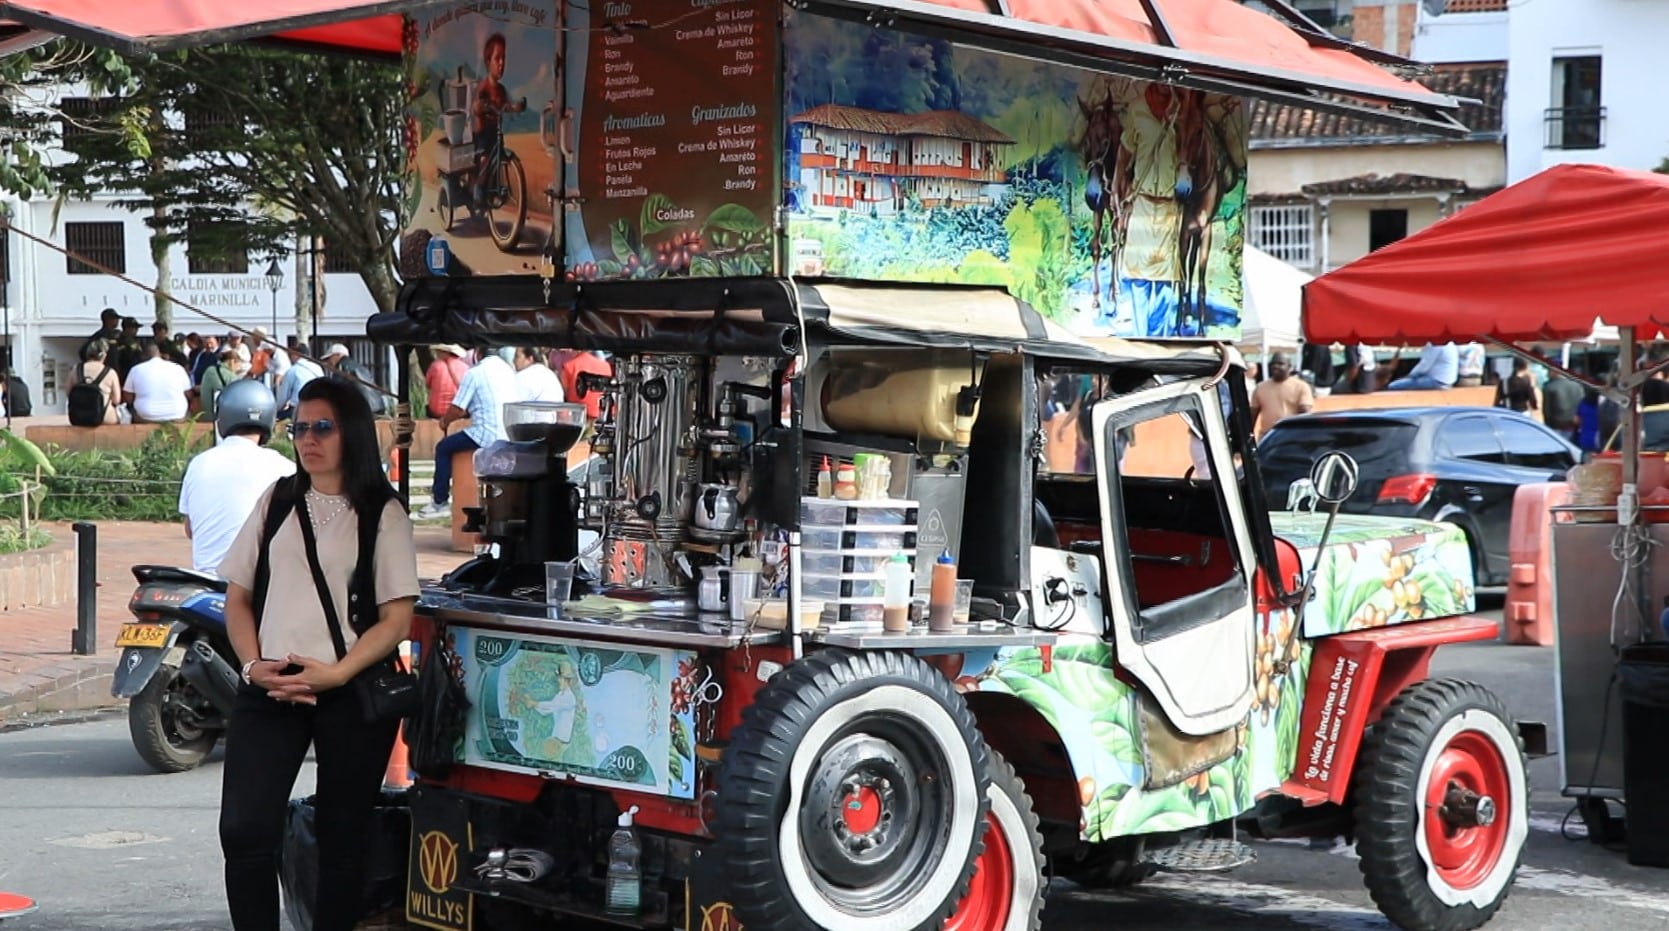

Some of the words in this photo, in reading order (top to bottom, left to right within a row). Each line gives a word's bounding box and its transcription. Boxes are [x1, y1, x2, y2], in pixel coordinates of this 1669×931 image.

[604, 2, 631, 17] Tinto
[715, 11, 730, 21] Sin
[731, 9, 754, 20] Licor
[675, 30, 703, 40] Crema
[704, 27, 715, 36] de
[716, 23, 754, 35] Whiskey
[717, 37, 754, 48] Amareto
[604, 49, 621, 59] Ron
[735, 50, 754, 61] Ron
[604, 61, 634, 73] Brandy
[722, 63, 754, 76] Brandy
[604, 87, 655, 102] Aguardiente
[692, 102, 757, 125] Granizados
[603, 111, 666, 133] Aromaticas
[717, 126, 731, 136] Sin
[733, 124, 756, 135] Licor
[605, 136, 631, 146] Limon
[678, 143, 705, 154] Crema
[707, 141, 717, 150] de
[719, 138, 756, 150] Whiskey
[605, 149, 631, 159] Frutos
[633, 147, 656, 159] Rojos
[719, 152, 756, 163] Amareto
[605, 162, 617, 172] En
[618, 161, 642, 171] Leche
[738, 164, 756, 175] Ron
[605, 174, 633, 185] Panela
[724, 178, 756, 190] Brandy
[606, 186, 648, 198] Manzanilla
[656, 208, 695, 221] Coladas
[171, 278, 216, 290] CALDIA
[189, 294, 259, 306] MARINILLA
[479, 640, 503, 655] 200
[1331, 656, 1345, 680] base
[1330, 682, 1339, 690] a
[1315, 691, 1336, 741] funciona
[1310, 739, 1323, 765] vida
[609, 754, 635, 769] 200
[411, 890, 464, 924] WILLYS
